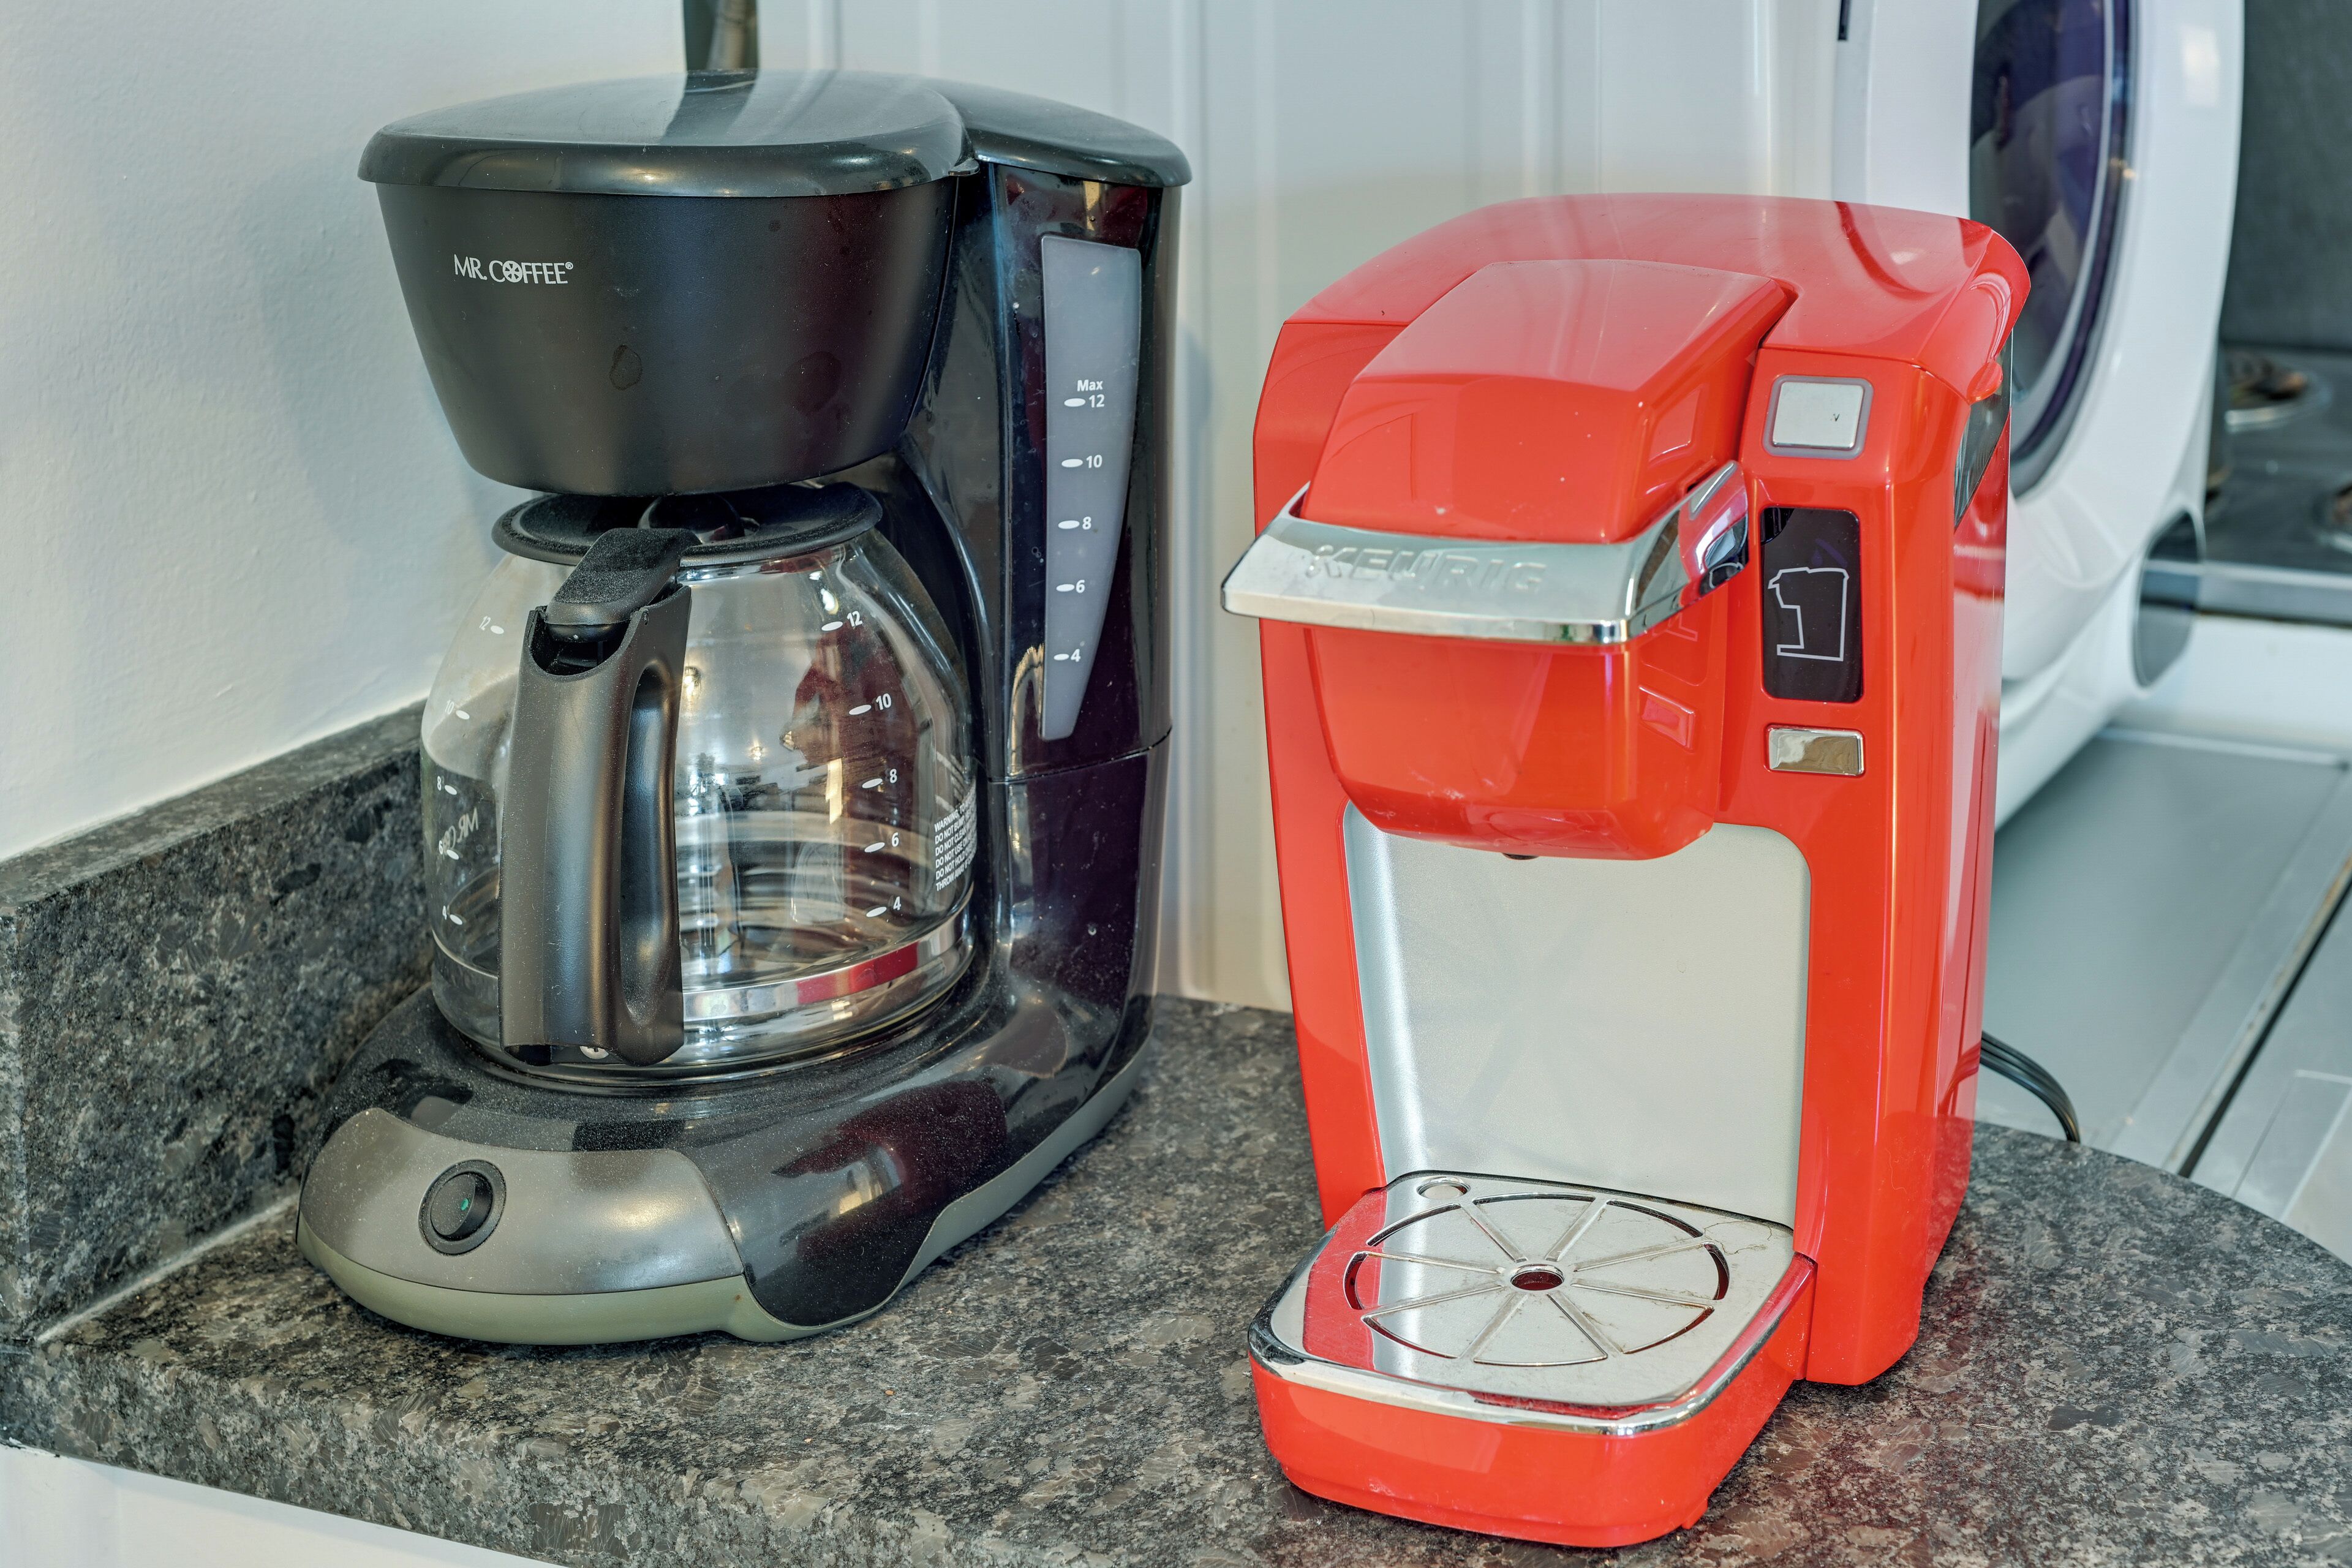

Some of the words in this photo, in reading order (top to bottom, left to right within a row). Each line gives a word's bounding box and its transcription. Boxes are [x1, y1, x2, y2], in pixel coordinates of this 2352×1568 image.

[454, 254, 488, 281] MR.
[1077, 379, 1104, 391] Max
[1089, 394, 1105, 408] 12
[1086, 454, 1102, 469] 10
[1082, 516, 1091, 530] 8
[1305, 545, 1548, 595] KEURIG
[1076, 579, 1085, 594] 6
[479, 616, 491, 631] 12
[847, 611, 863, 627] 12
[1071, 649, 1080, 663] 4
[445, 699, 454, 715] 10
[876, 693, 892, 710] 10
[437, 775, 442, 791] 8
[889, 768, 897, 783] 8
[891, 832, 899, 847] 6
[935, 832, 943, 845] DO
[944, 824, 954, 839] NOT
[439, 840, 443, 855] 6
[935, 844, 944, 856] DO
[944, 836, 954, 851] NOT
[935, 856, 944, 869] DO
[944, 848, 954, 863] NOT
[936, 868, 944, 880] DO
[944, 860, 955, 874] NOT
[955, 851, 965, 867] HOLD
[936, 872, 954, 891] THROW
[893, 896, 901, 910] 4
[442, 905, 447, 920] 4
